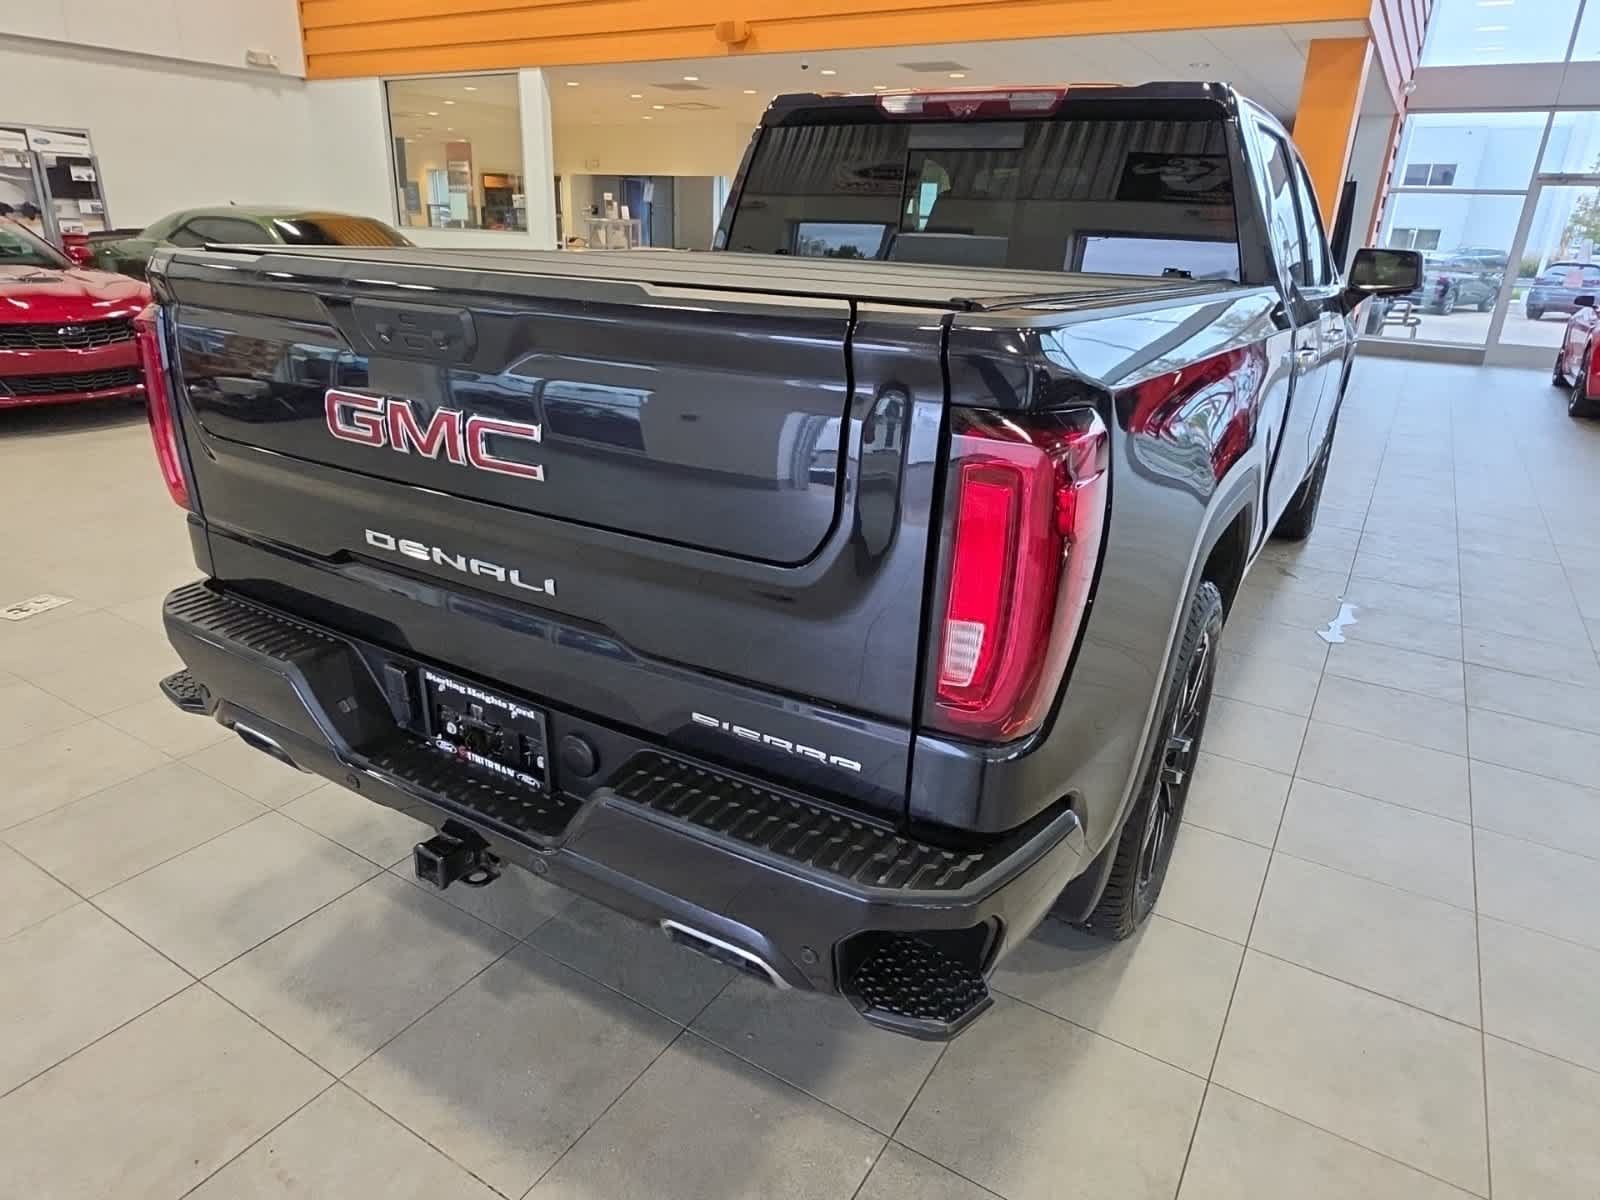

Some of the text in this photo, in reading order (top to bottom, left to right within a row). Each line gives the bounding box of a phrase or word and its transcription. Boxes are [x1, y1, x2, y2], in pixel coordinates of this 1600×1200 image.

[324, 389, 545, 482] GMC
[365, 528, 556, 597] DENALI
[425, 671, 536, 720] Sterling Heights Ford
[691, 711, 862, 772] SIERRA
